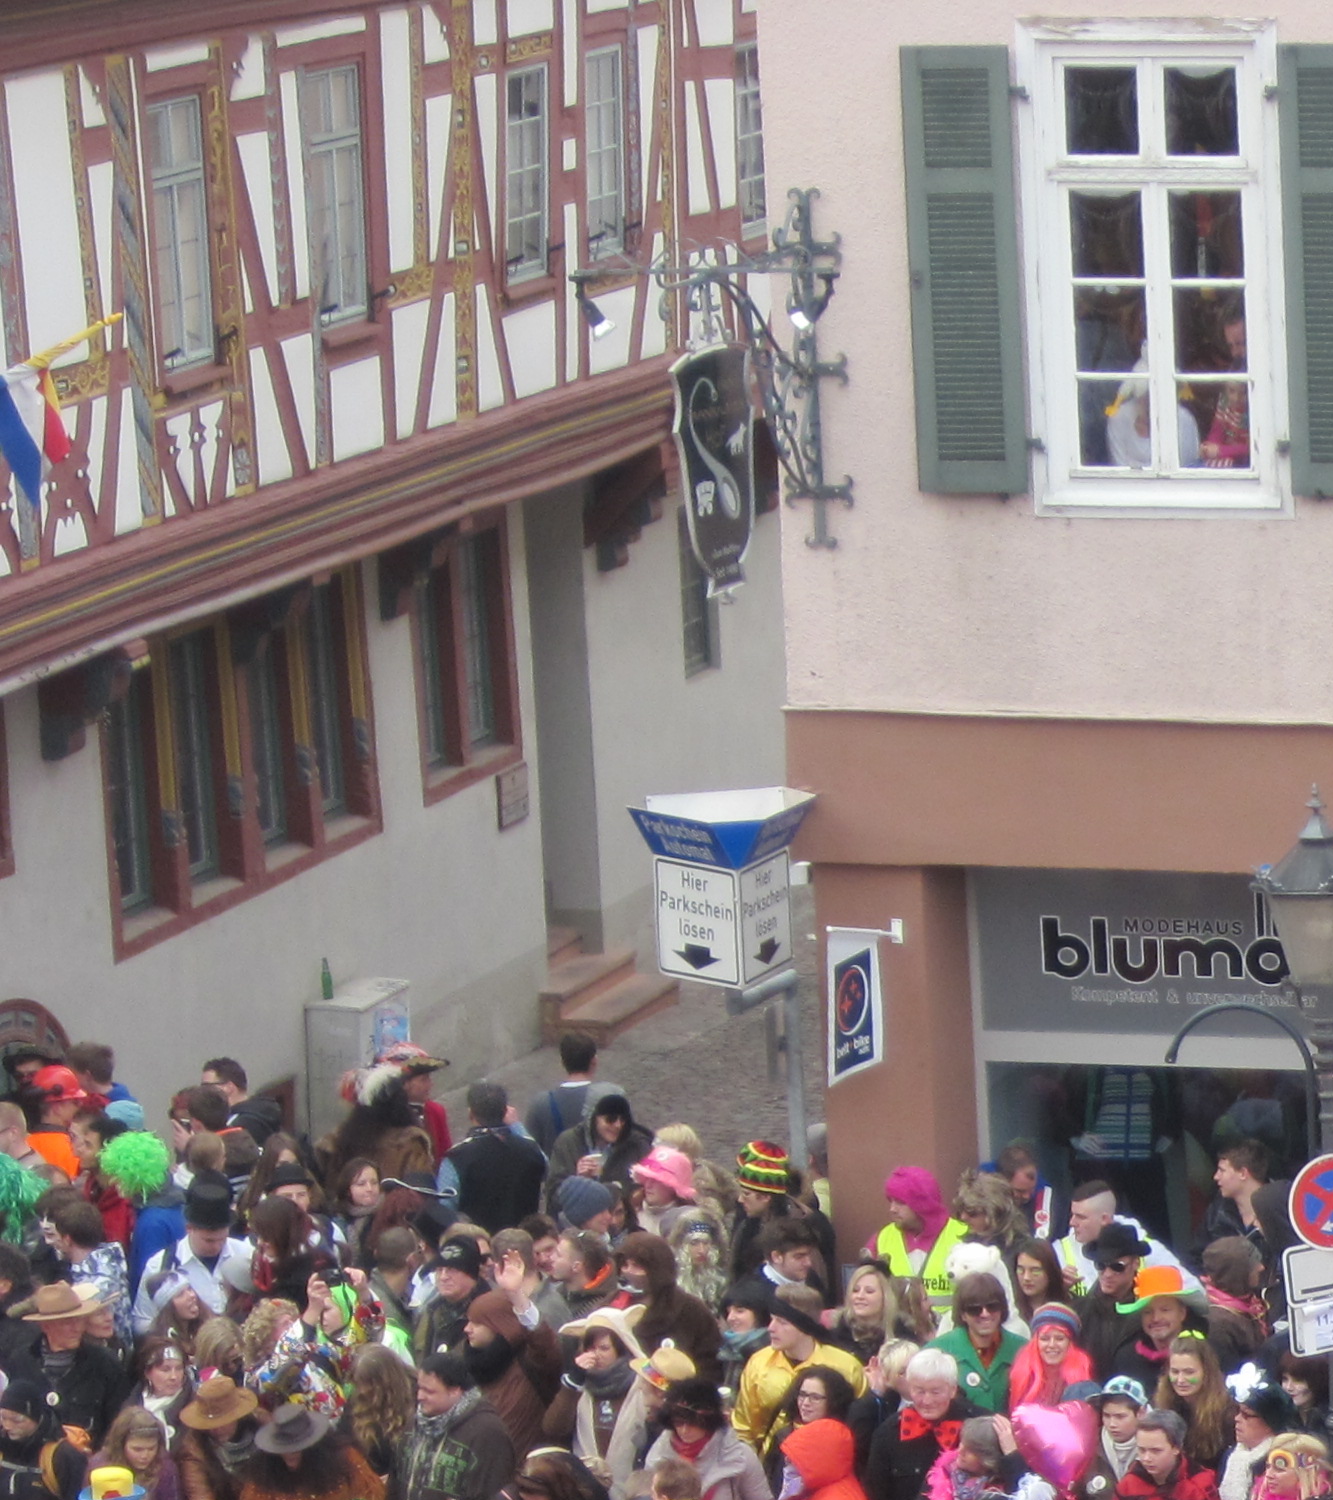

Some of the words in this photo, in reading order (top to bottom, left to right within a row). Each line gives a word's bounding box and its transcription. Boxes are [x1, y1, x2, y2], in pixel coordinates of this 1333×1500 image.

[681, 870, 708, 892] Hier
[755, 869, 772, 889] Hier
[659, 890, 733, 922] Parkschein
[743, 886, 788, 918] Parkschein
[679, 917, 715, 941] lösen
[755, 916, 777, 938] lösen
[1124, 918, 1243, 935] MODEHAUS
[1040, 892, 1288, 986] blumö
